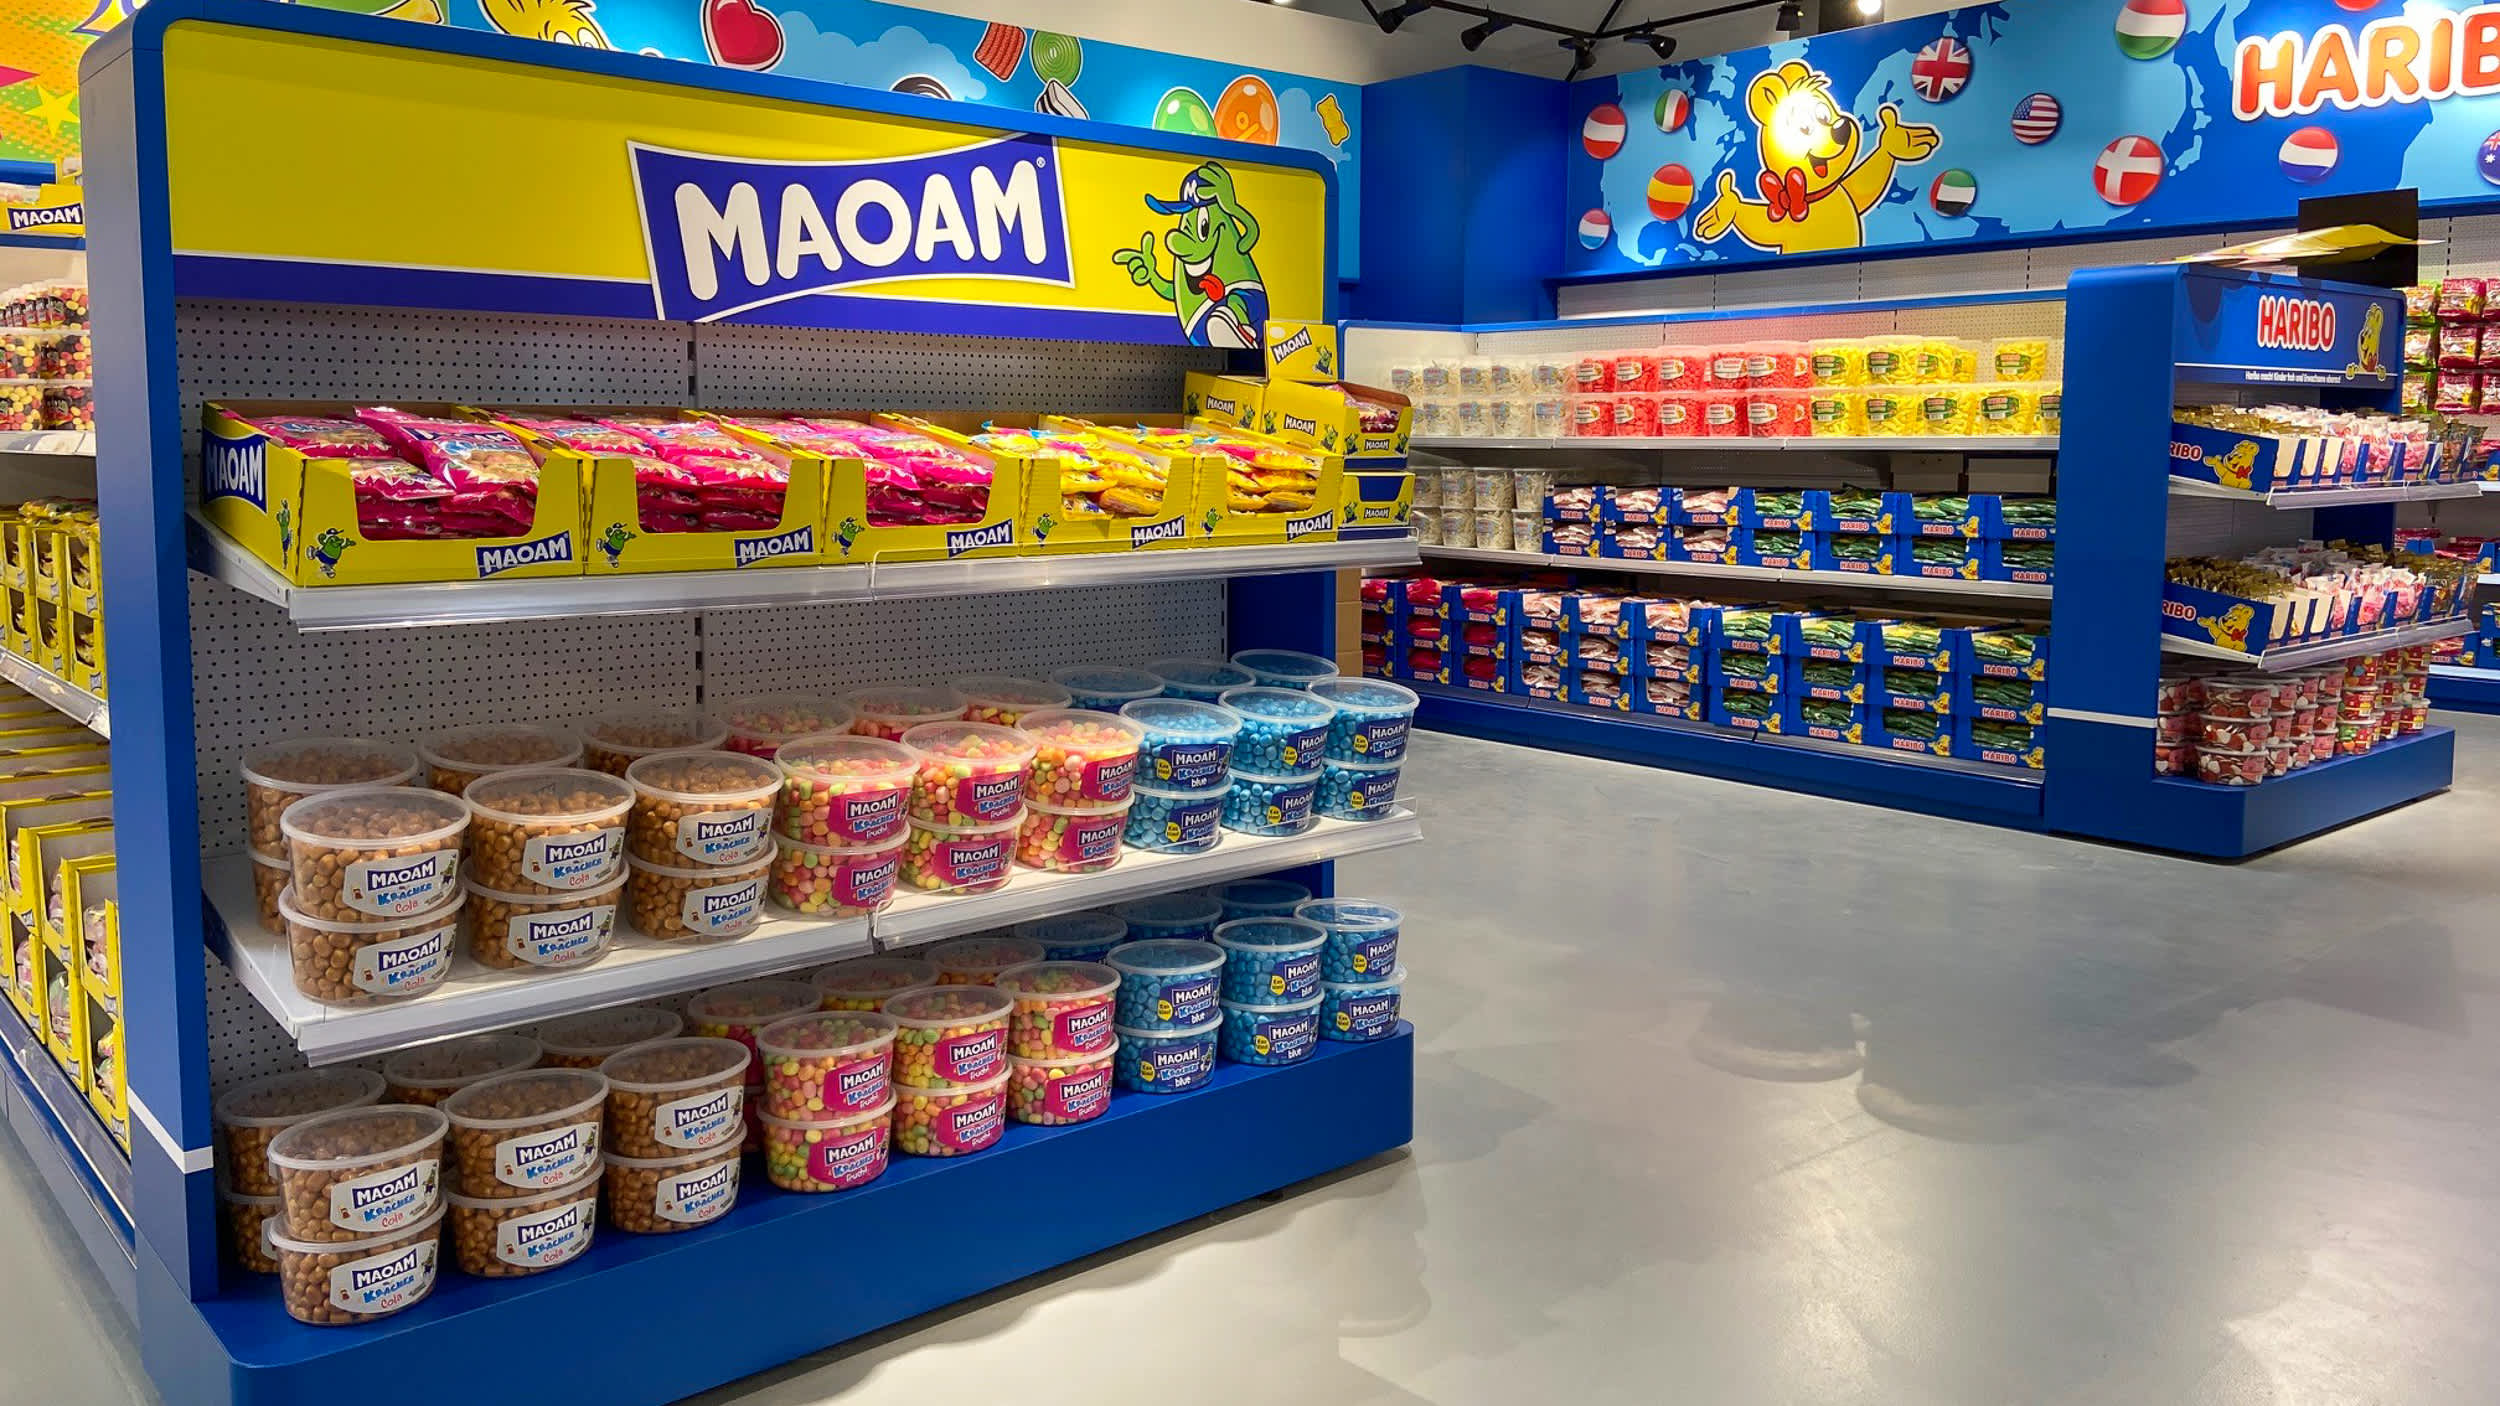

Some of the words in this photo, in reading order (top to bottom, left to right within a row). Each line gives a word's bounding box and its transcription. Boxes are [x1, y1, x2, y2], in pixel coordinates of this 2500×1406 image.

[2237, 10, 2500, 116] HARIB
[13, 207, 80, 227] MAOAM
[675, 160, 1047, 300] MAOAM
[2259, 296, 2335, 350] HARIBO
[1273, 332, 1309, 361] MAOAM
[1208, 398, 1234, 412] MAOAM
[1286, 418, 1314, 433] MAOAM
[1366, 440, 1389, 449] MAOAM
[206, 445, 262, 501] MAOAM
[1366, 508, 1389, 518] MAOAM
[1134, 520, 1182, 547] MAOAM
[1289, 514, 1331, 538] MAOAM
[1840, 521, 1869, 531] HARIBO
[1923, 525, 1954, 535] HARIBO
[2013, 528, 2046, 538] HARIBO
[740, 532, 809, 562] MAOAM
[952, 526, 1010, 554] MAOAM
[483, 538, 568, 573] MAOAM
[1840, 560, 1869, 571] HARIBO
[1923, 566, 1953, 577] HARIBO
[2013, 571, 2046, 581] HARIBO
[1894, 656, 1925, 667] HARIBO
[1984, 665, 2018, 676] HARIBO
[1894, 697, 1925, 709] HARIBO
[1983, 708, 2016, 720] HARIBO
[1372, 724, 1404, 739] MAOAM
[1893, 738, 1925, 750] HARIBO
[1176, 750, 1216, 765] MAOAM
[1983, 751, 2016, 763] HARIBO
[1101, 760, 1132, 780] MAOAM
[976, 778, 1018, 798] MAOAM
[1191, 777, 1207, 787] blue
[1368, 779, 1396, 795] MAOAM
[850, 796, 896, 816] MAOAM
[1185, 808, 1219, 826] MAOAM
[702, 818, 752, 838] MAOAM
[1082, 825, 1118, 843] MAOAM
[550, 838, 604, 861] MAOAM
[954, 846, 998, 863] MAOAM
[372, 861, 434, 888] MAOAM
[569, 875, 589, 886] Cola
[856, 862, 894, 885] MAOAM
[396, 900, 418, 913] Cola
[708, 886, 755, 911] MAOAM
[534, 916, 590, 939] MAOAM
[382, 937, 439, 968] MAOAM
[1370, 940, 1396, 956] MAOAM
[1288, 960, 1318, 978] MAOAM
[404, 977, 425, 990] Cola
[1176, 983, 1211, 1003] MAOAM
[1353, 1000, 1388, 1016] MAOAM
[1071, 1010, 1107, 1032] MAOAM
[1192, 1012, 1205, 1024] blue
[1272, 1022, 1308, 1039] MAOAM
[954, 1036, 995, 1060] MAOAM
[1158, 1048, 1198, 1066] MAOAM
[1288, 1049, 1301, 1058] blue
[844, 1062, 884, 1089] MAOAM
[1175, 1076, 1191, 1086] blue
[1064, 1076, 1102, 1098] MAOAM
[678, 1097, 726, 1125] MAOAM
[956, 1103, 996, 1127] MAOAM
[520, 1134, 575, 1163] MAOAM
[828, 1137, 874, 1163] MAOAM
[542, 1171, 563, 1184] Cola
[679, 1170, 726, 1199] MAOAM
[357, 1173, 415, 1206] MAOAM
[382, 1213, 403, 1227] Cola
[522, 1211, 575, 1242] MAOAM
[544, 1248, 563, 1262] Cola
[357, 1254, 415, 1287] MAOAM
[381, 1294, 402, 1308] Cola
